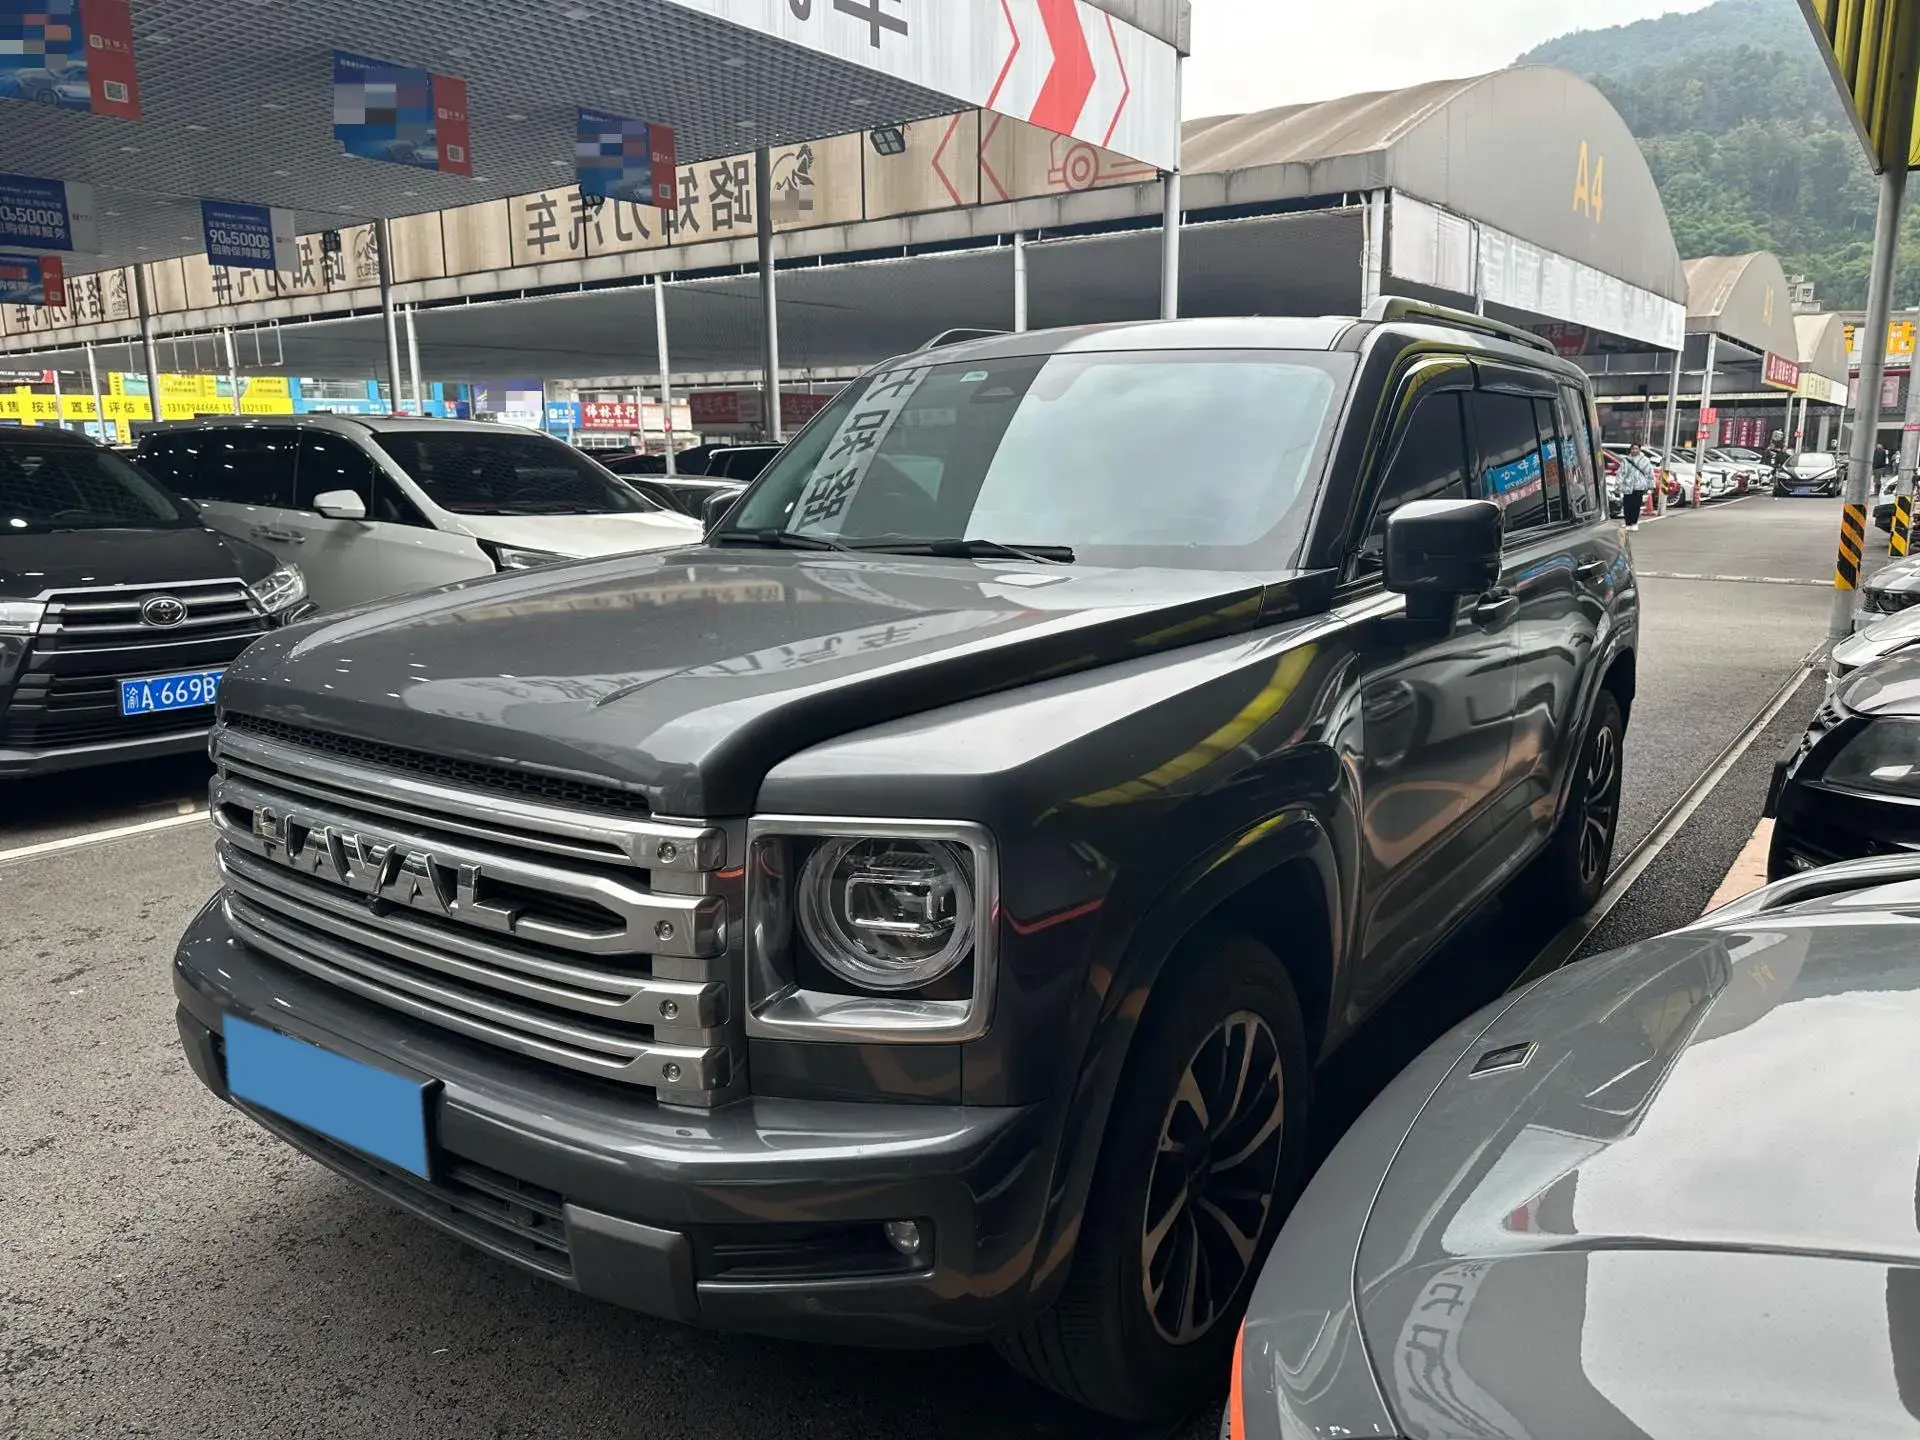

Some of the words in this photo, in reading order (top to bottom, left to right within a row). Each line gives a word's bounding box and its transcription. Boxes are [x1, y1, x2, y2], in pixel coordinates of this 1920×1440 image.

[1573, 140, 1604, 224] A4
[109, 402, 135, 413] 评估
[252, 806, 520, 934] HAVAL
